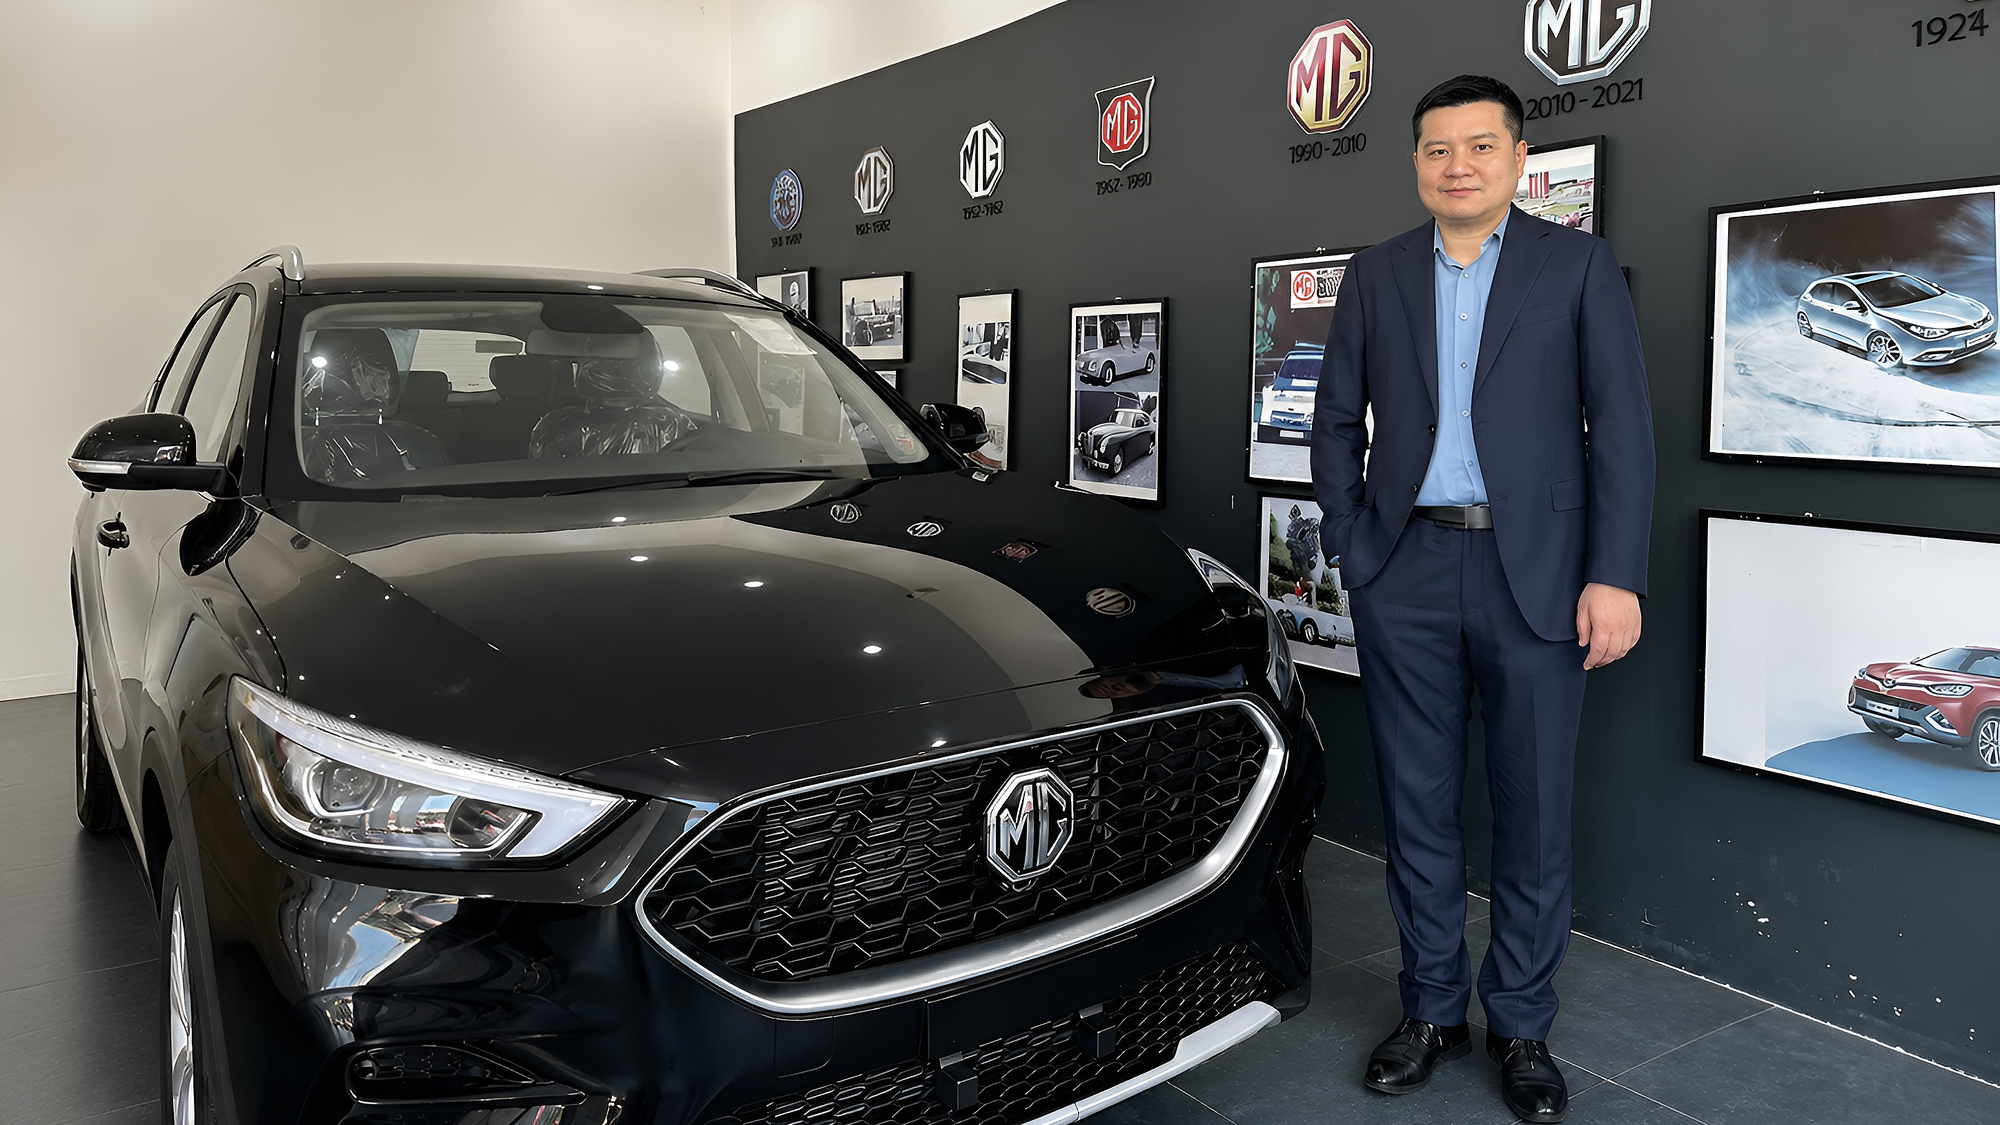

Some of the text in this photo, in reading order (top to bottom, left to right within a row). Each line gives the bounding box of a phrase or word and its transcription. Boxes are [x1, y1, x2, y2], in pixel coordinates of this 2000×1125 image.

[1537, 0, 1636, 69] MG
[1911, 8, 1989, 47] 1924
[1296, 32, 1362, 122] MG
[1106, 99, 1139, 147] MG
[1288, 133, 1367, 164] 1990-2010
[857, 156, 888, 210] MG
[963, 127, 999, 192] MG
[999, 782, 1068, 870] MG
